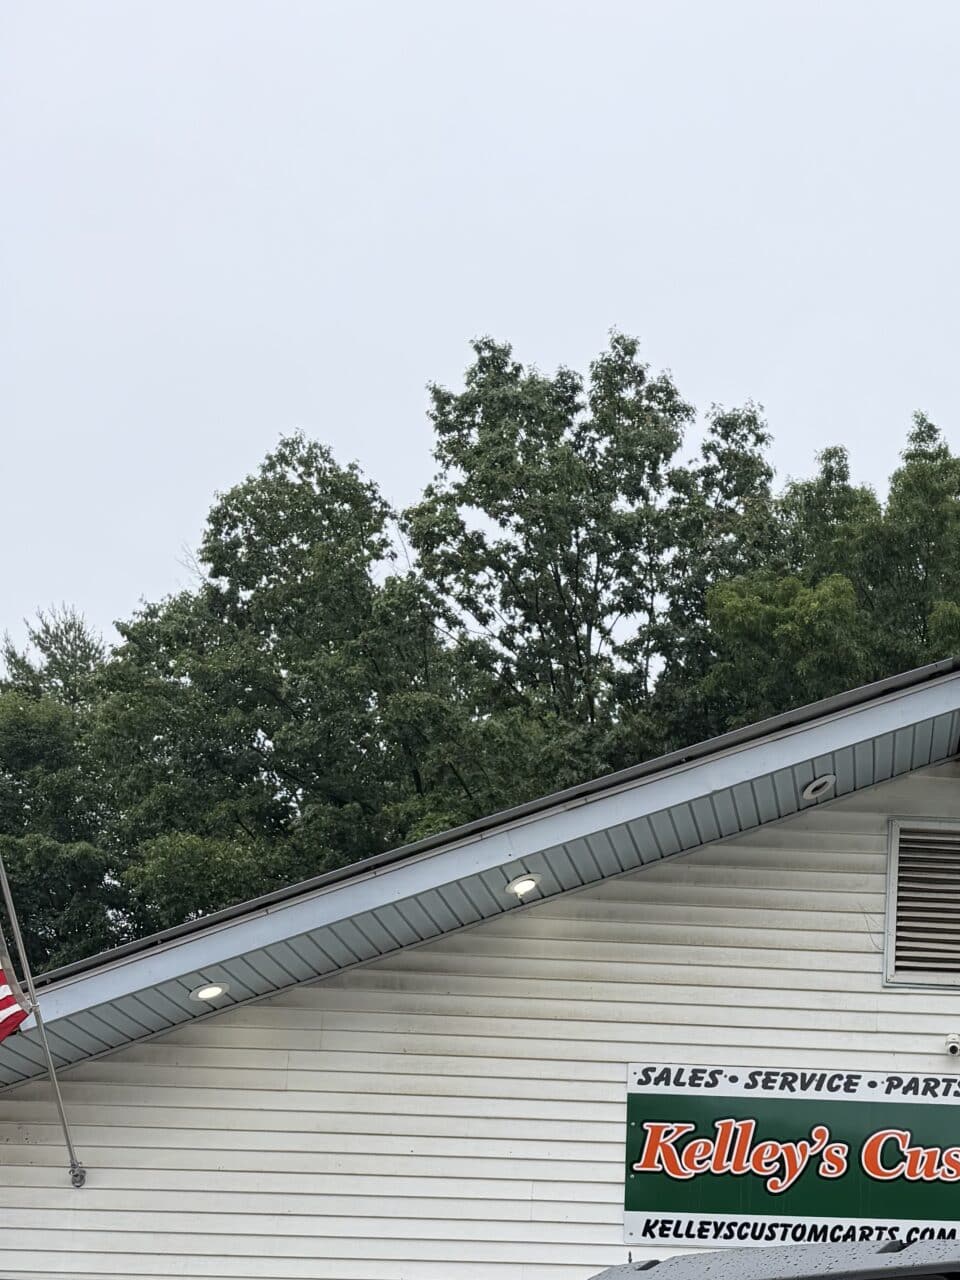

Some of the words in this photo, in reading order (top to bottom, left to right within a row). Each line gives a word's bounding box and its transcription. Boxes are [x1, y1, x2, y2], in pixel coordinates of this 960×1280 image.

[637, 1067, 723, 1088] SALES
[744, 1070, 862, 1093] SERVICE
[633, 1119, 848, 1193] Kelley's
